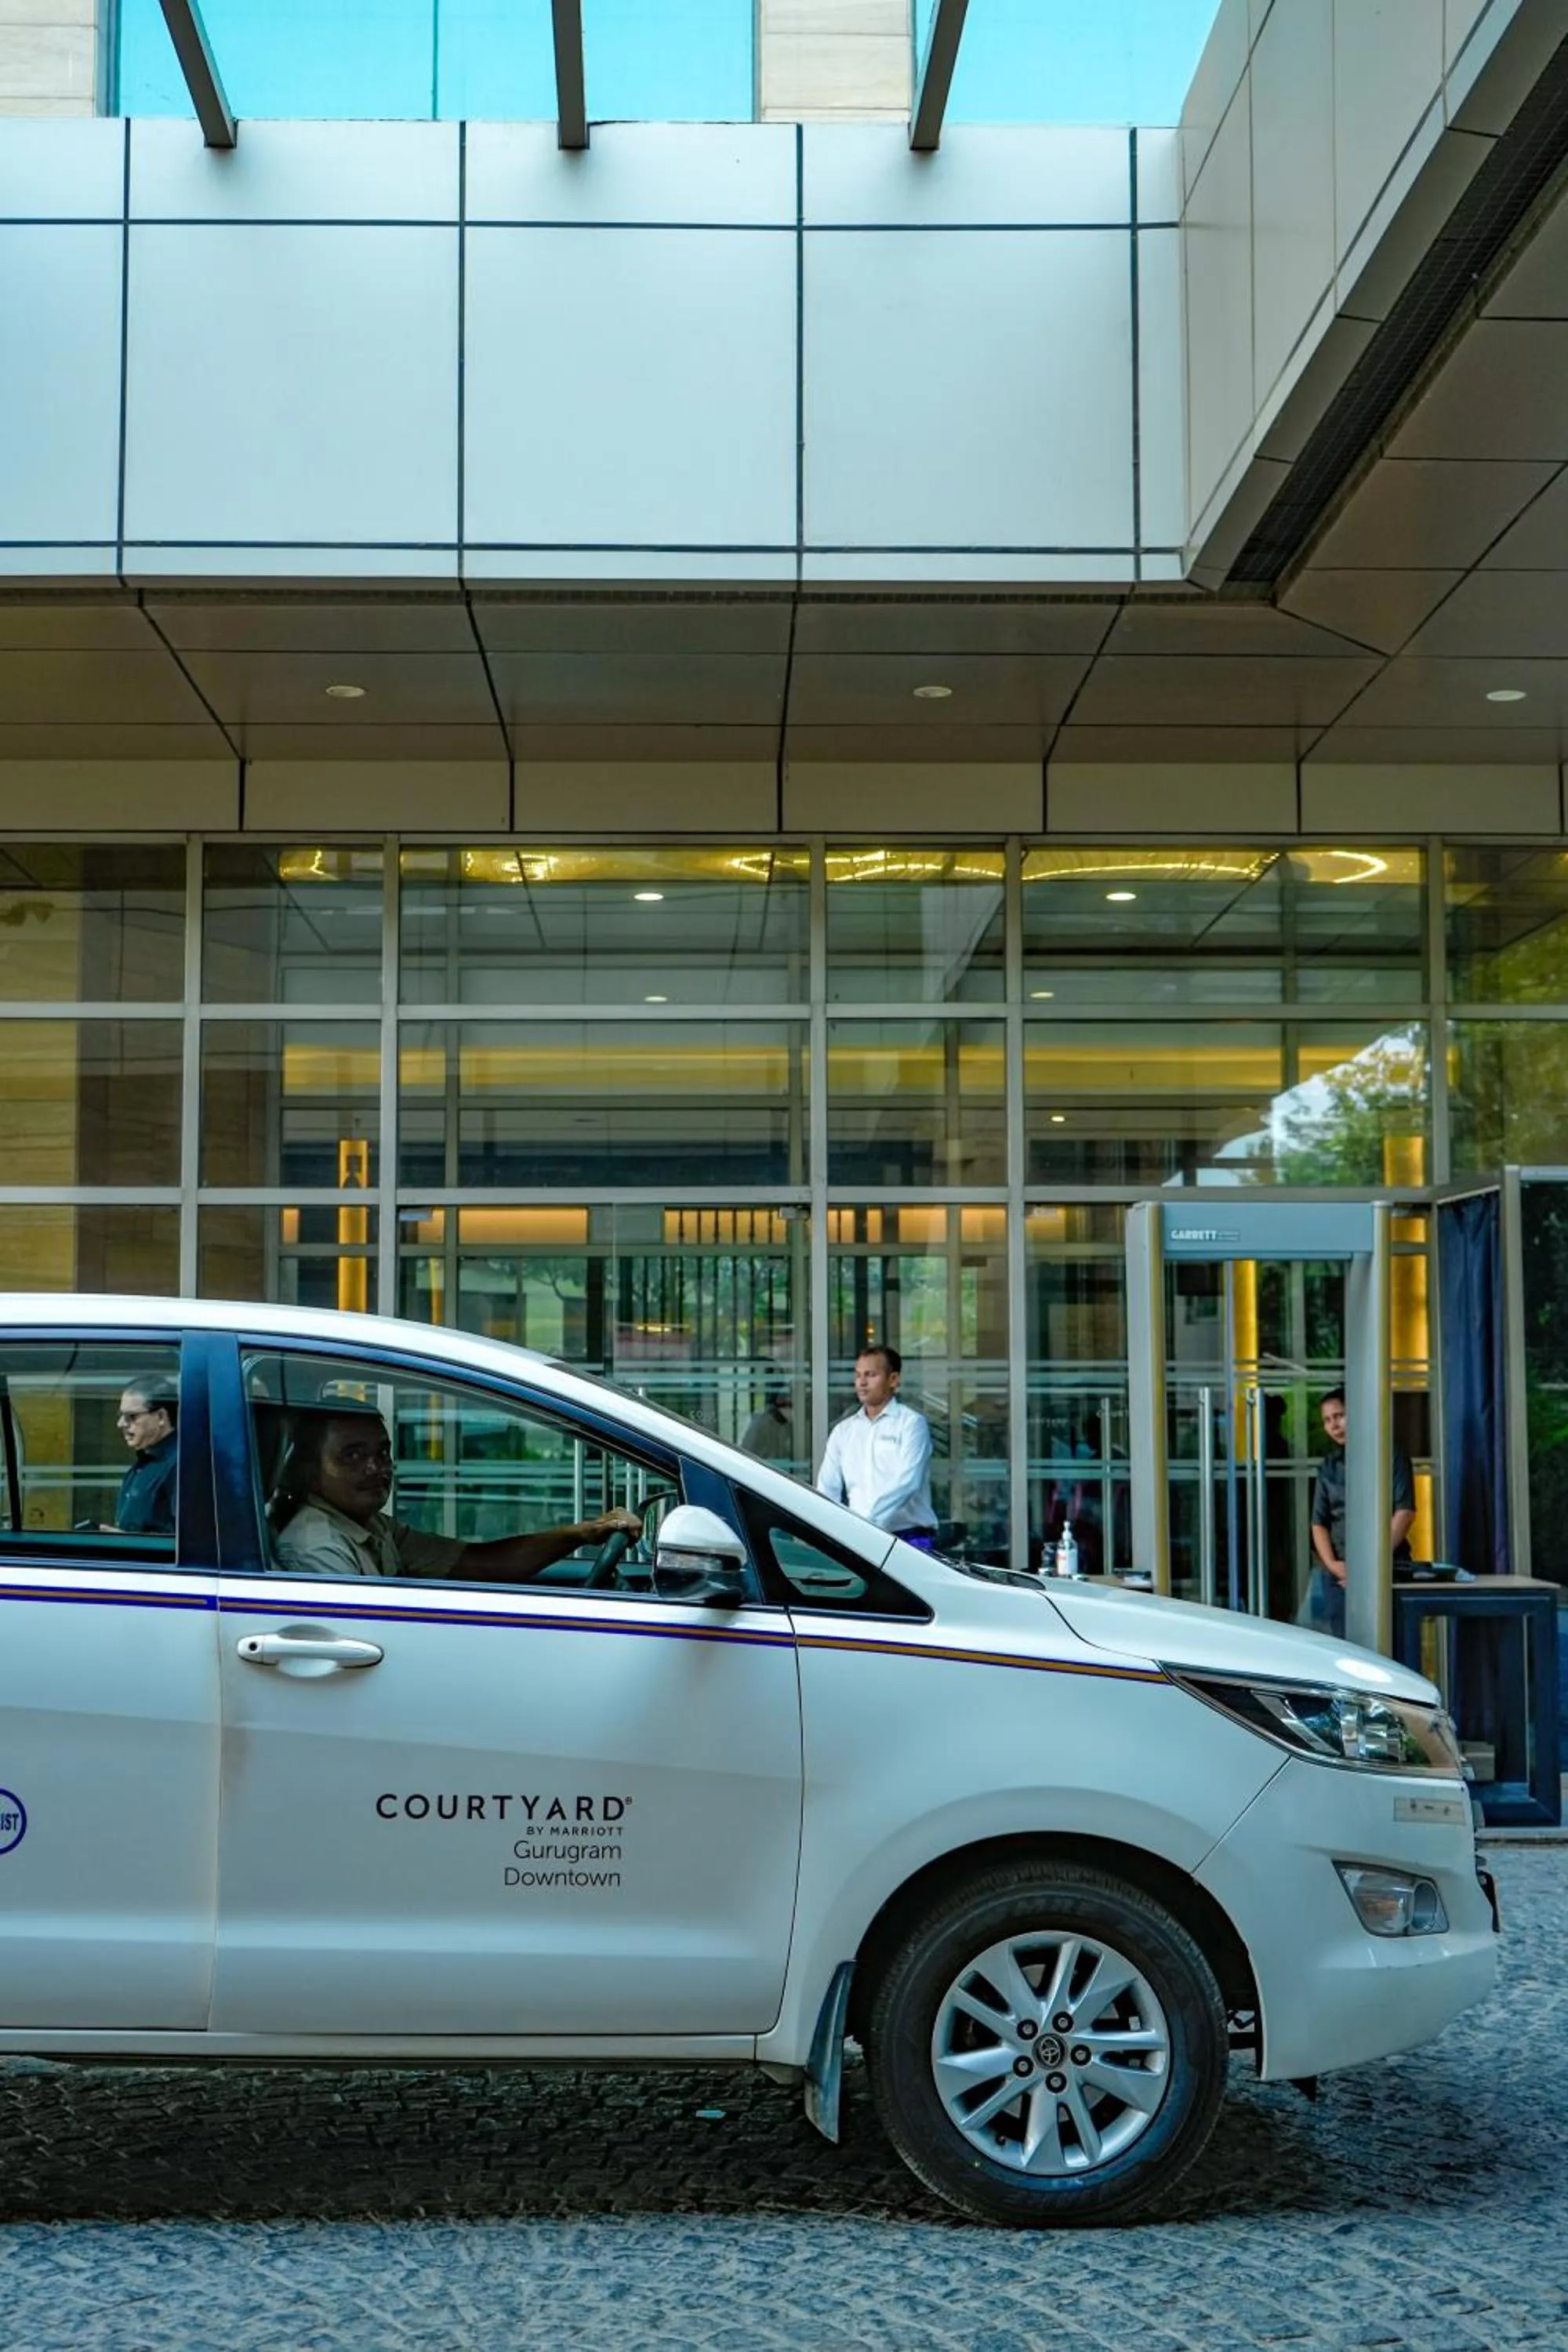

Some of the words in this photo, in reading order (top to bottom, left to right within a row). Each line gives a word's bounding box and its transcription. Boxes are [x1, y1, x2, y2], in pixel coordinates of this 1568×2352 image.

[376, 1793, 625, 1821] COURTYARD
[526, 1826, 545, 1835] BY
[550, 1827, 624, 1837] MARRIOTT
[514, 1840, 622, 1864] Gurugram
[504, 1867, 621, 1886] Downtown
